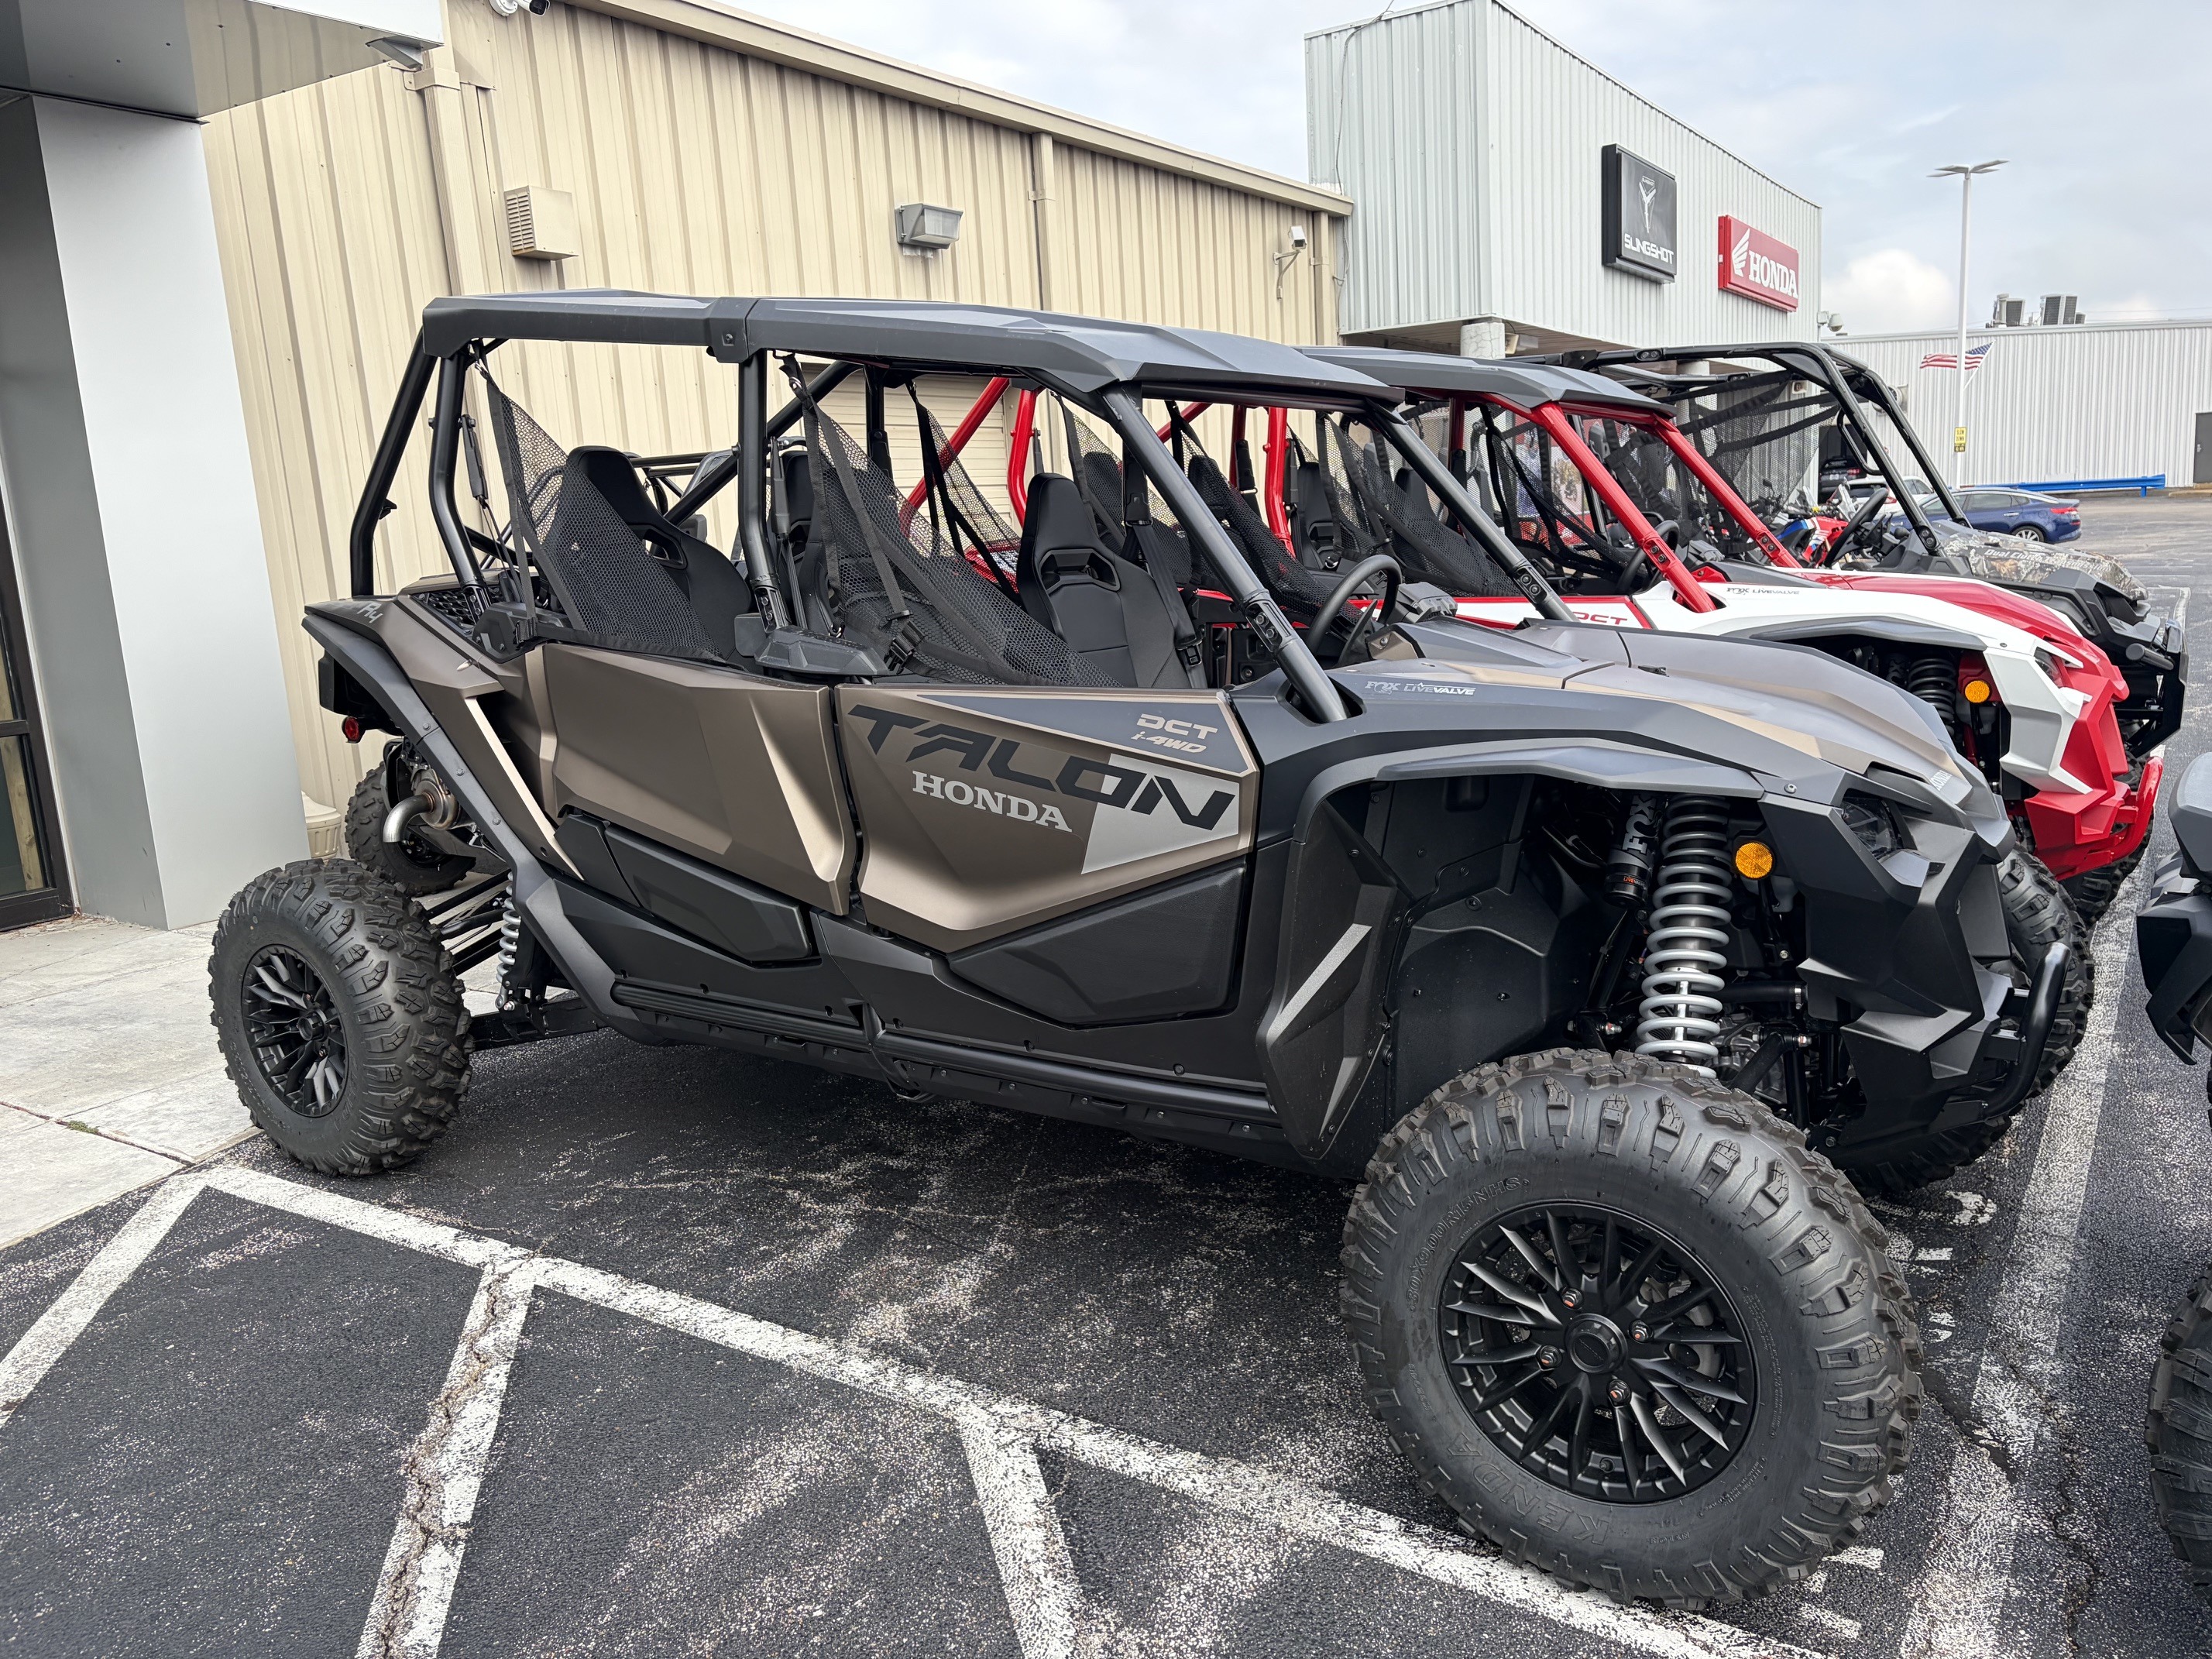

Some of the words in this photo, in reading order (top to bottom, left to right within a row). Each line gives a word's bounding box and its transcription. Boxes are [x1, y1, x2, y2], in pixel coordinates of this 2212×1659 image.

[1624, 233, 1674, 264] SLINGSHOT
[1748, 249, 1798, 299] HONDA
[1984, 548, 2009, 558] Dual
[1572, 611, 1628, 625] DCT
[1365, 681, 1401, 695] FOX
[1131, 731, 1207, 753] i-4WD
[1137, 713, 1218, 740] DCT
[848, 703, 1236, 830] TALON
[912, 771, 1073, 833] HONDA
[1622, 795, 1660, 854] FOX
[1448, 1432, 1609, 1545] KENDA
